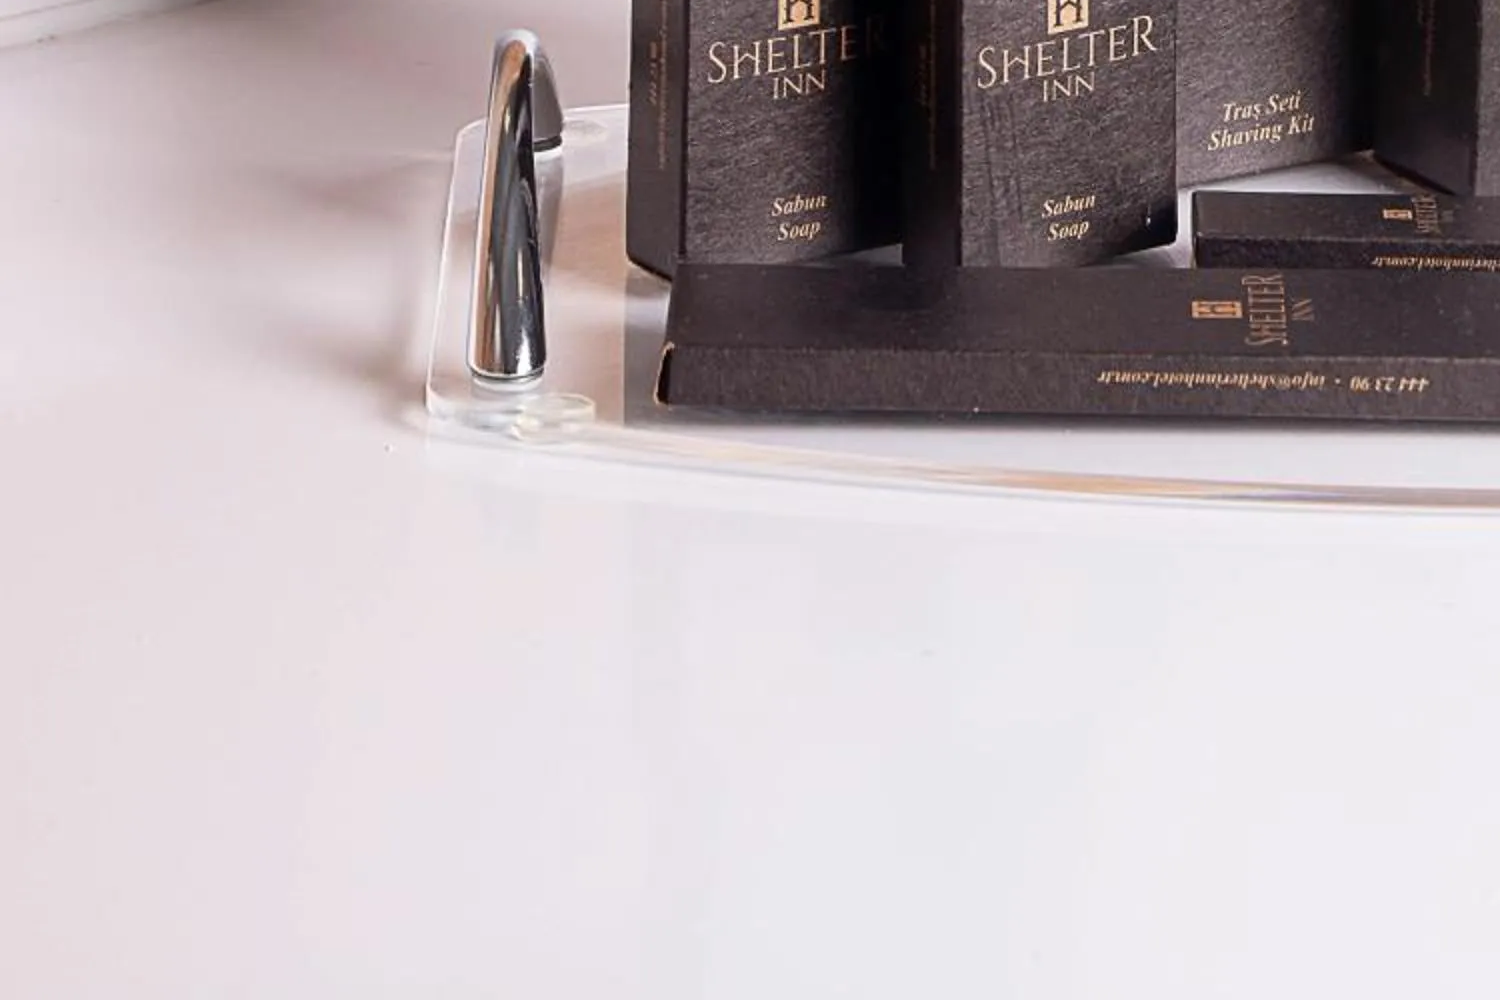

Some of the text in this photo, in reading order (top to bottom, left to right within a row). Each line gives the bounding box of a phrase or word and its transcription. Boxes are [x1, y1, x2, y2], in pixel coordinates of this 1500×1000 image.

[977, 15, 1157, 89] SHELTER
[772, 69, 827, 100] INN
[1043, 72, 1096, 102] INN
[1223, 90, 1302, 122] Traş Seti
[1207, 113, 1315, 151] Shaving Kit
[771, 193, 828, 217] Sabun
[1041, 194, 1096, 218] Sabun
[777, 219, 822, 242] Soap
[1047, 219, 1089, 242] Soap
[1241, 274, 1288, 346] SHELTER
[1350, 375, 1370, 392] 90
[1374, 376, 1395, 393] 23
[1399, 376, 1430, 393] 444
